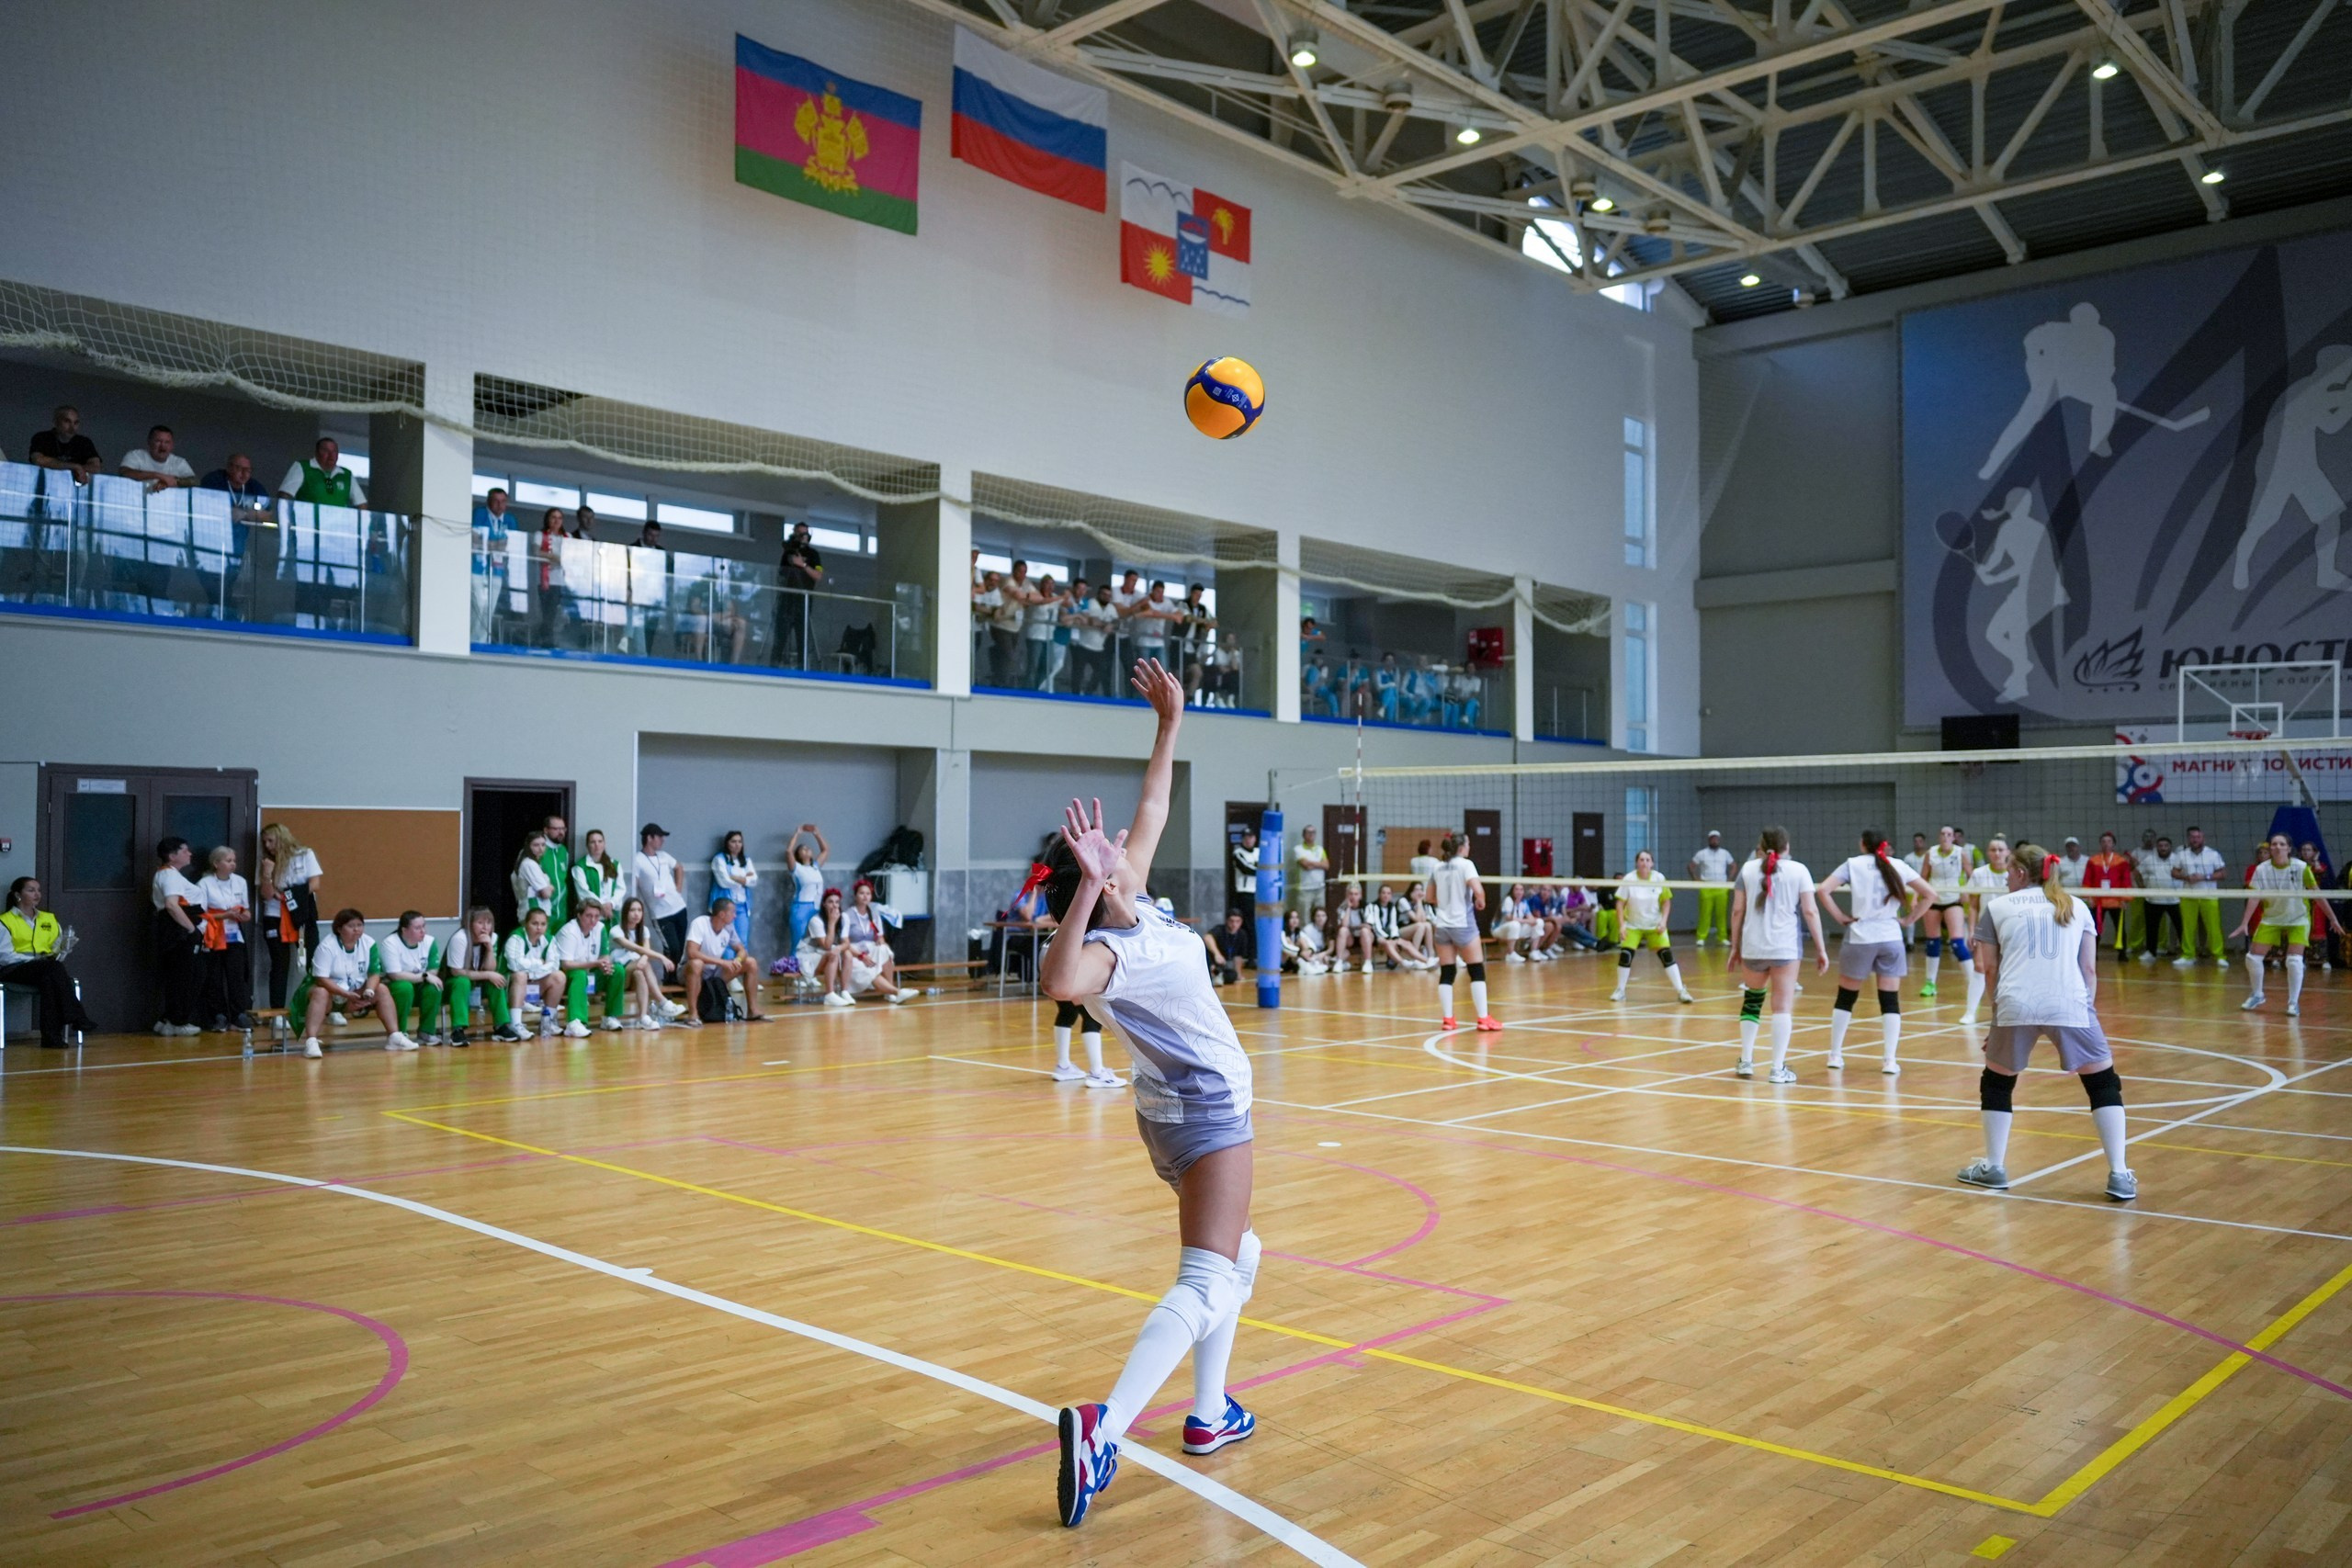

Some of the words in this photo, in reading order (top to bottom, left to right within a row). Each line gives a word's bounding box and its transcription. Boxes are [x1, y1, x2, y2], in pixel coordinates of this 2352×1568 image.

[2159, 638, 2352, 678] ЮНОСТ
[2008, 895, 2050, 905] ЧУРАШ
[2018, 908, 2060, 960] 10
